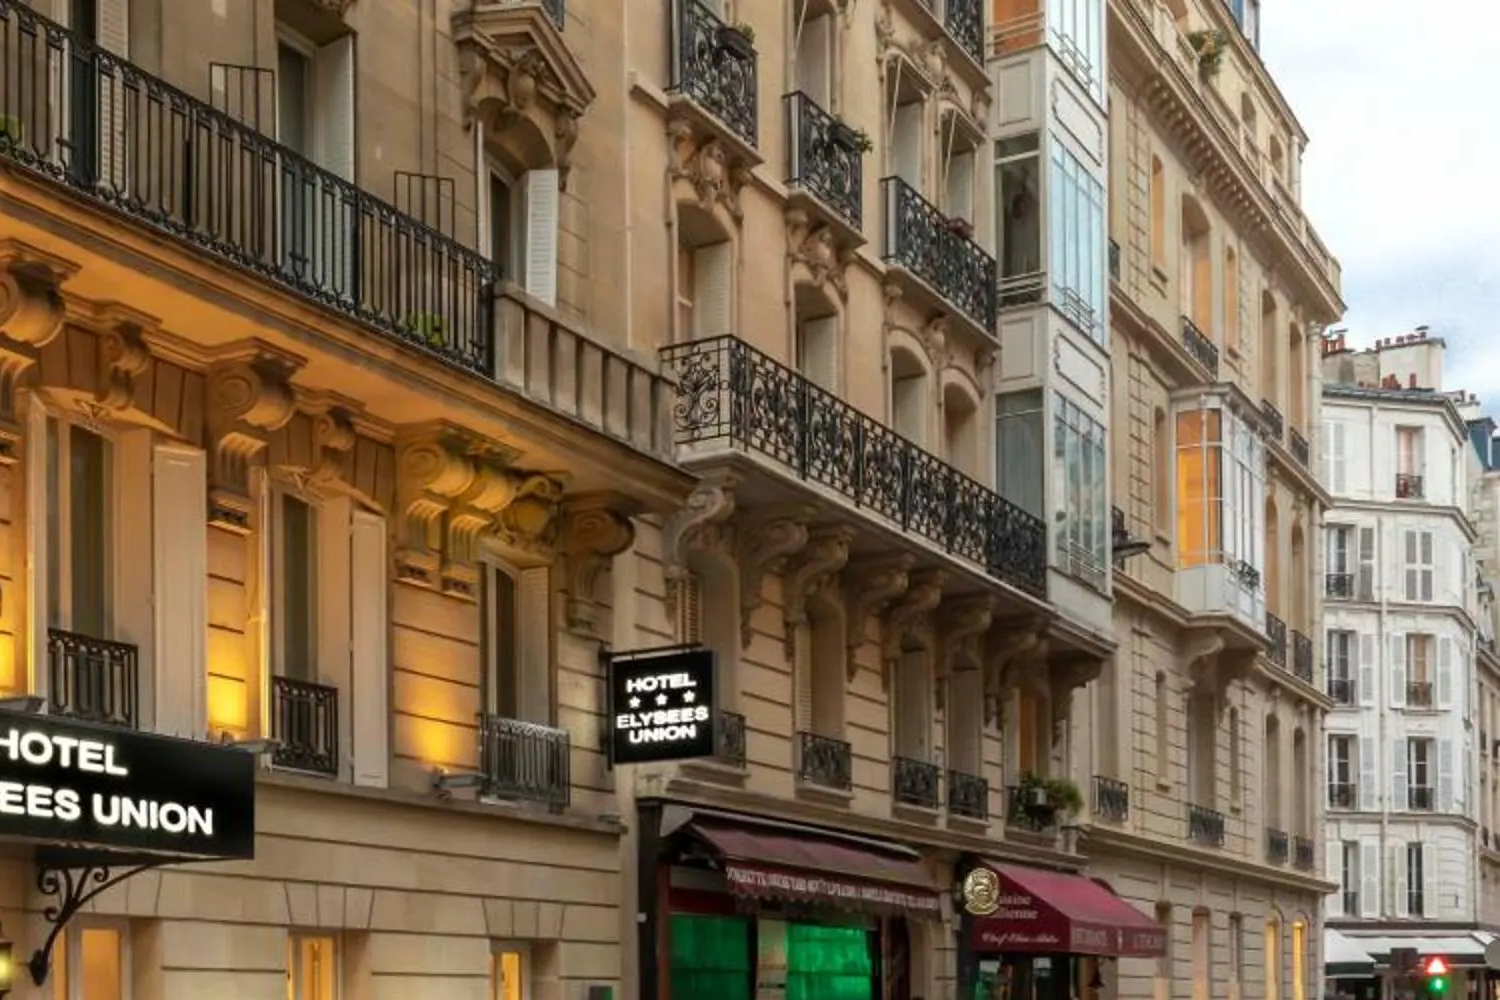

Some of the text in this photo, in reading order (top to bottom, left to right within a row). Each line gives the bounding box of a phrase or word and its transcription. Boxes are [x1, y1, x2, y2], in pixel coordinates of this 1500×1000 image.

[626, 672, 697, 693] HOTEL
[616, 705, 709, 729] ELYSEES
[629, 724, 697, 744] UNION
[92, 791, 214, 836] UNION
